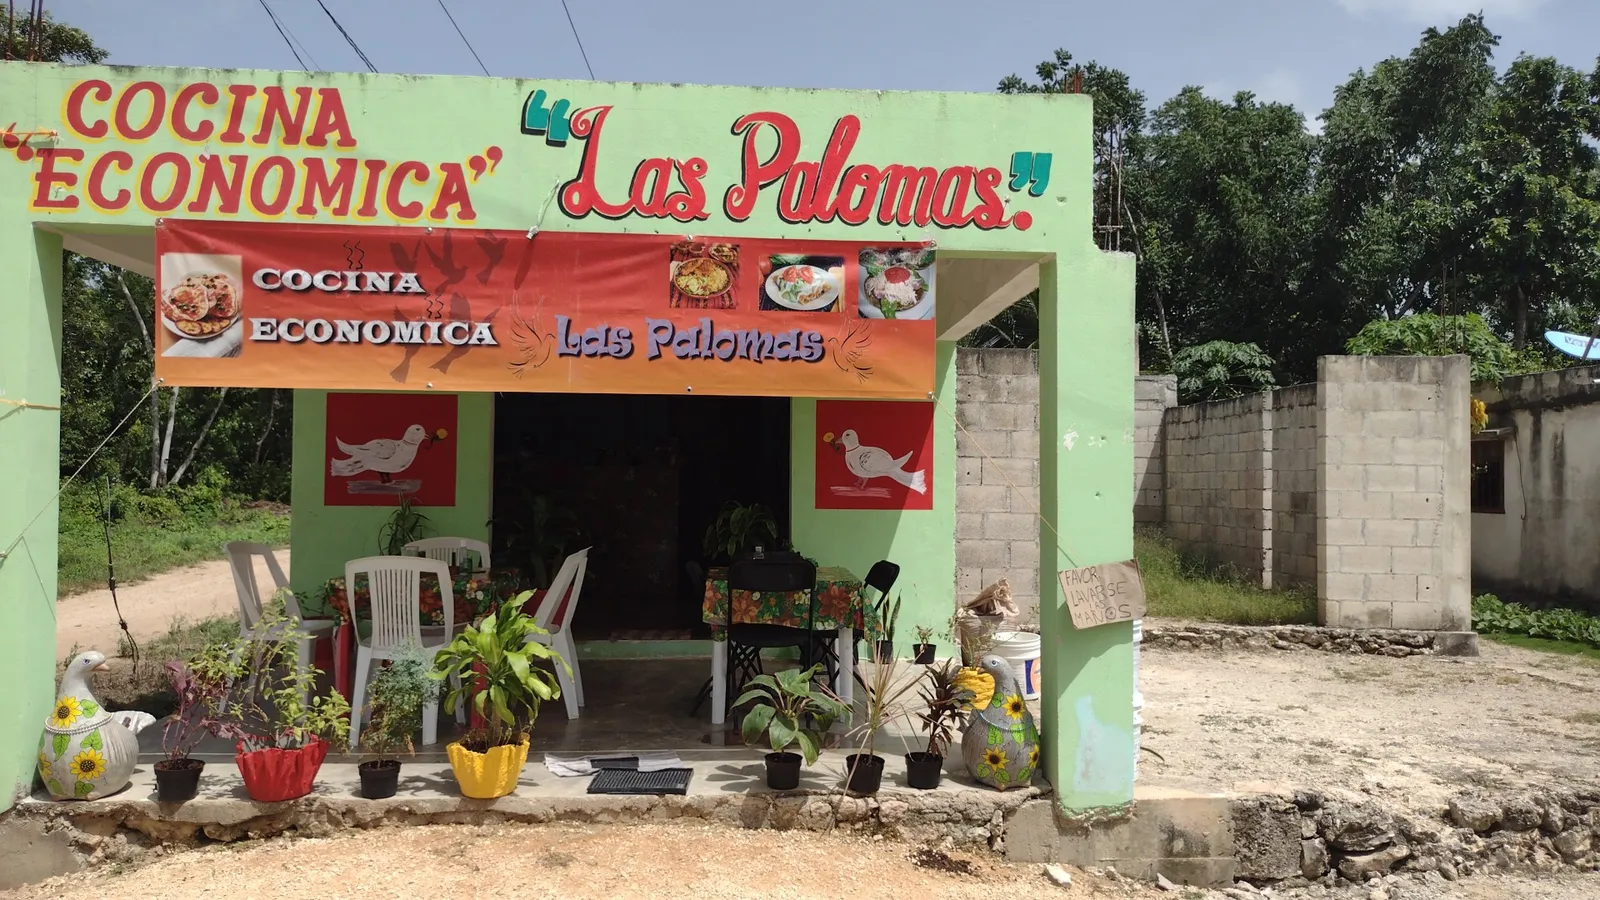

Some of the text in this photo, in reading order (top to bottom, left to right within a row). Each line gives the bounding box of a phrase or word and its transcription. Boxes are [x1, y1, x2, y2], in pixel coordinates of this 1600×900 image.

[63, 78, 358, 148] COCINA
[251, 267, 426, 295] COCINA
[248, 317, 499, 347] ECONOMICA
[554, 314, 827, 362] Las Palomas
[1065, 566, 1099, 586] FAVOR
[1070, 581, 1127, 607] LAVARSE
[1074, 604, 1132, 626] MANOS
